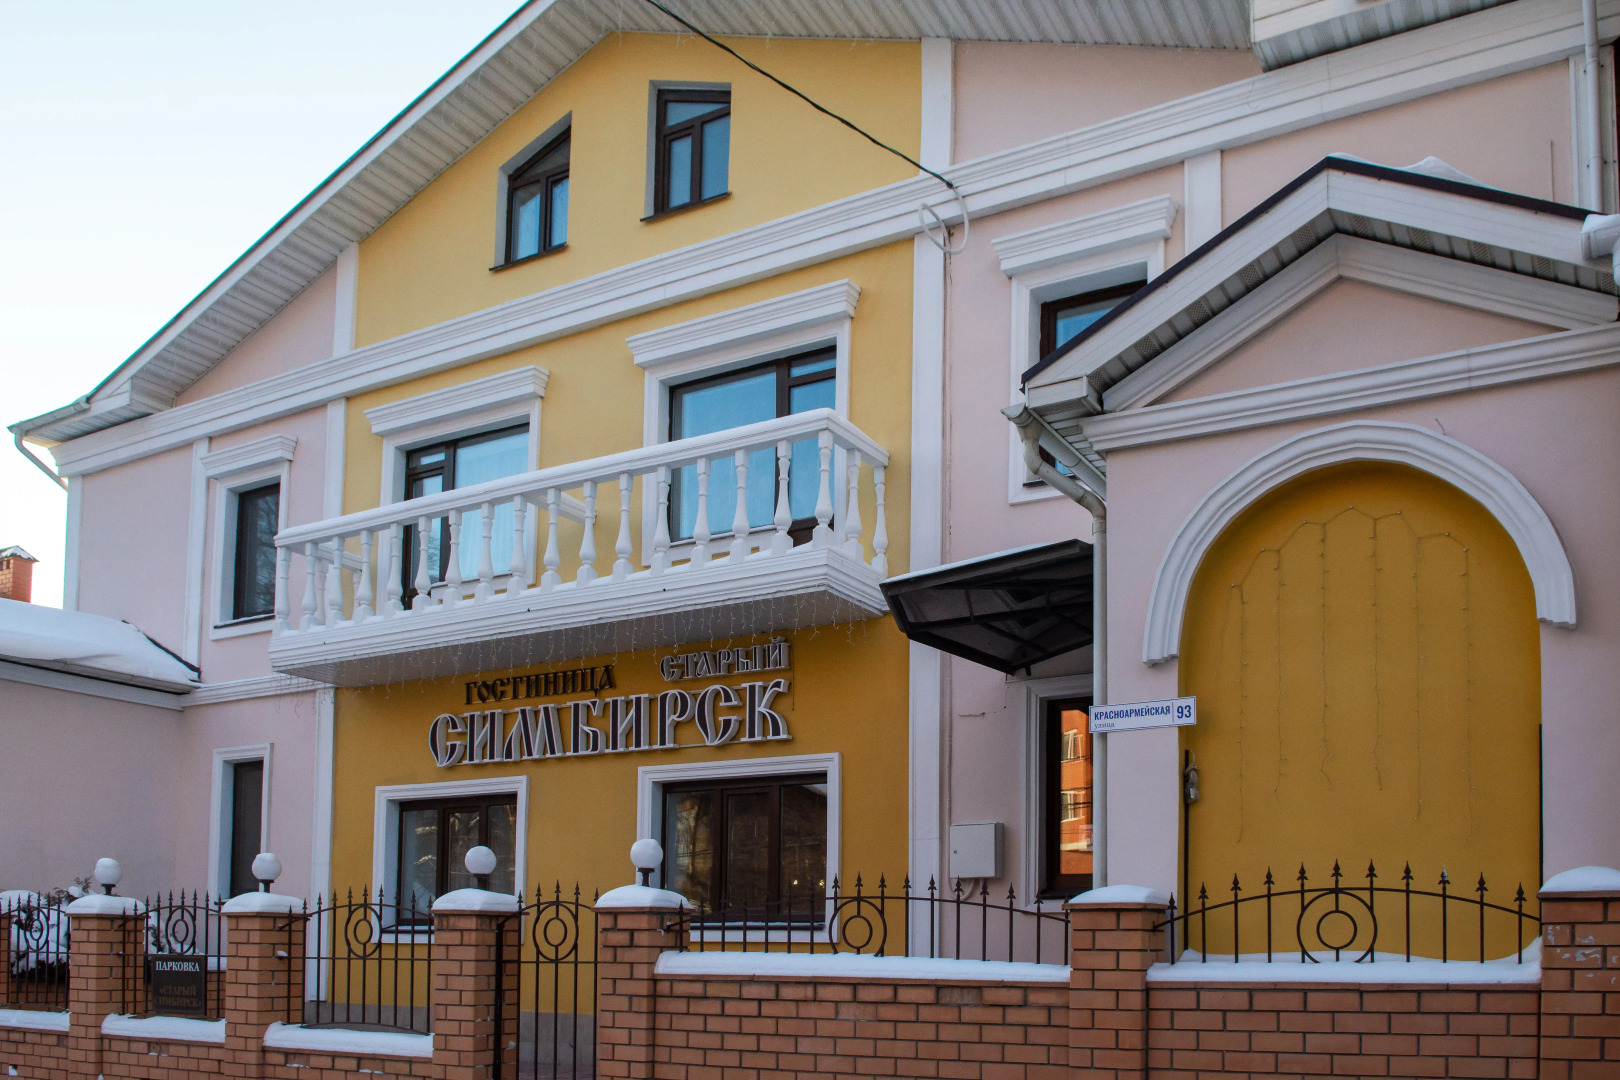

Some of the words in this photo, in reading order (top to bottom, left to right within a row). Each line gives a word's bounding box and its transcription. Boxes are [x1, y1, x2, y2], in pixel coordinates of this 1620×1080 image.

[464, 665, 616, 705] ГОСТИНИЦА
[660, 636, 791, 681] СТАРЫЙ
[1094, 705, 1171, 721] КРАСНОАРМЕЙСКАЯ
[1177, 704, 1192, 719] 93
[429, 679, 792, 767] СИМБИРСК
[1094, 722, 1115, 730] улица
[155, 960, 200, 972] ПАРКОВКА
